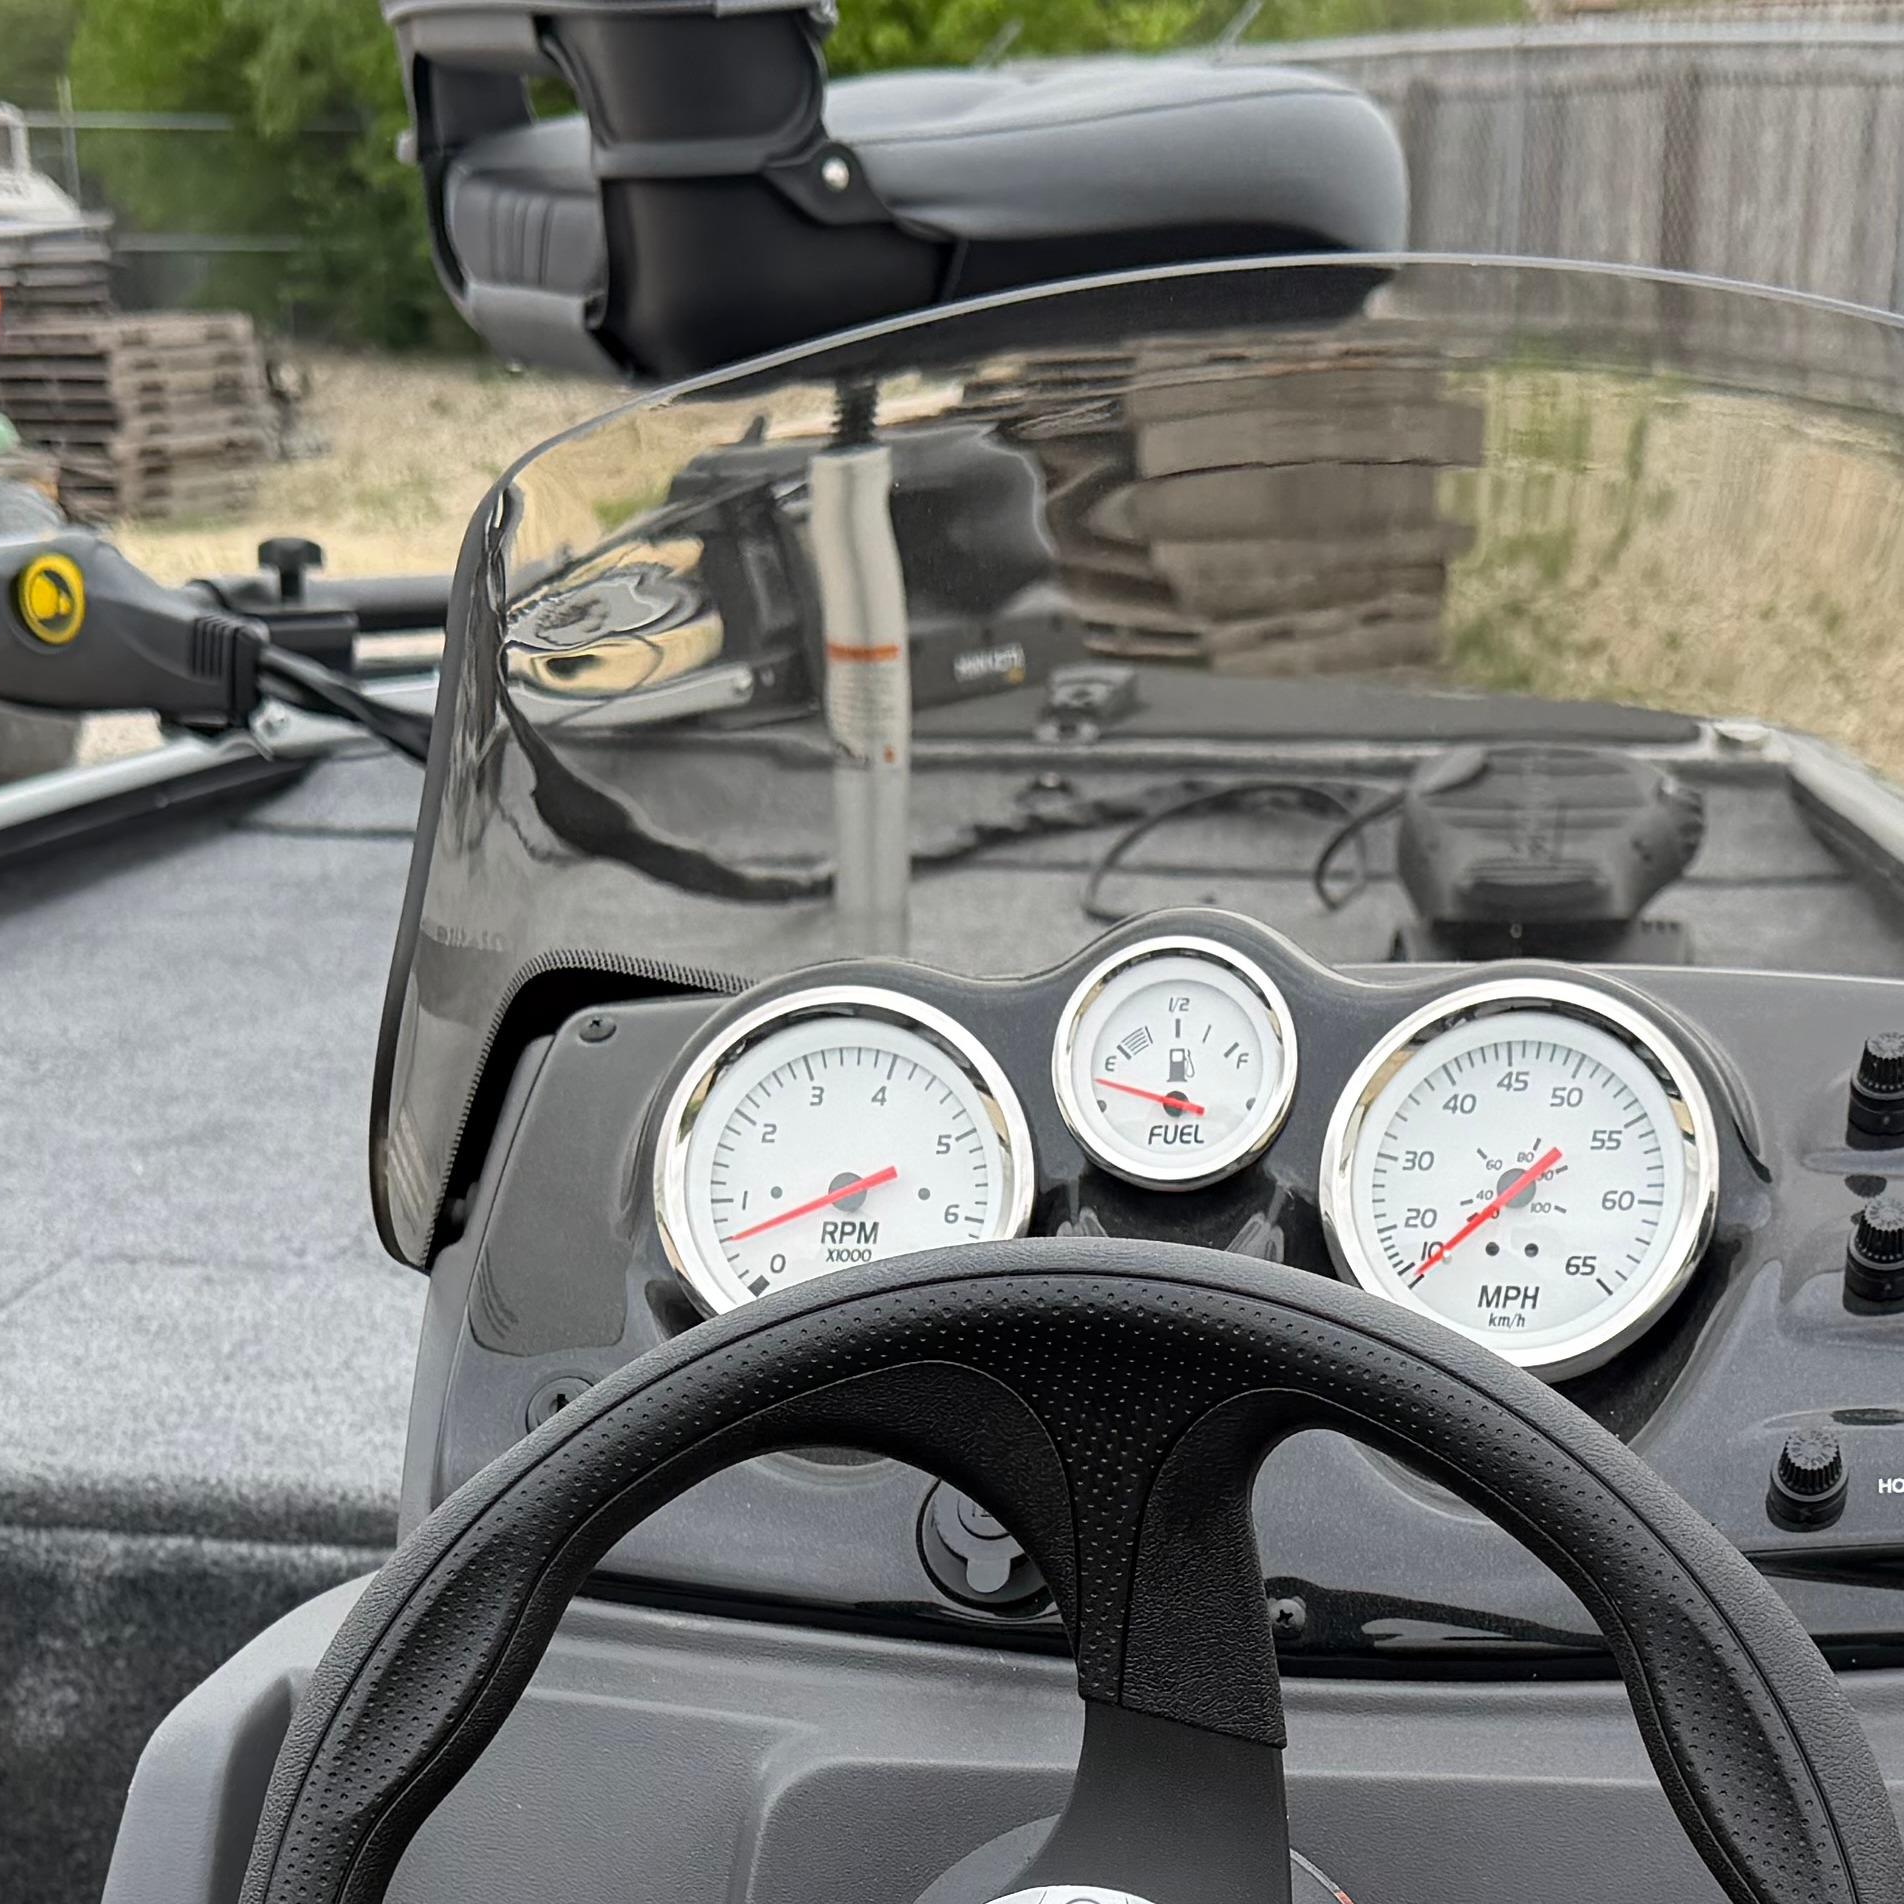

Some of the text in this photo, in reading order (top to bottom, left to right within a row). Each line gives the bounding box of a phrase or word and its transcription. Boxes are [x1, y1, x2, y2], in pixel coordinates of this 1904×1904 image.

[1168, 997, 1190, 1012] 1/2
[1105, 1056, 1116, 1072] E
[1236, 1053, 1249, 1070] F
[1497, 1071, 1530, 1092] 45
[809, 1087, 824, 1106] 3
[871, 1086, 887, 1106] 4
[1442, 1094, 1477, 1114] 40
[1550, 1087, 1583, 1107] 50
[761, 1123, 778, 1143] 2
[1148, 1124, 1204, 1145] FUEL
[1590, 1130, 1622, 1150] 55
[936, 1134, 952, 1155] 5
[1402, 1150, 1434, 1171] 30
[1486, 1159, 1502, 1170] 60
[742, 1190, 748, 1210] 1
[1476, 1190, 1494, 1201] 40
[1601, 1190, 1635, 1211] 60
[944, 1205, 960, 1224] 6
[1530, 1202, 1552, 1214] 100
[1404, 1208, 1437, 1229] 20
[821, 1221, 880, 1245] RPM
[770, 1254, 786, 1273] 0
[826, 1248, 872, 1262] X1000
[1565, 1255, 1597, 1276] 65
[1477, 1285, 1540, 1309] MPH
[1488, 1313, 1526, 1328] km/h
